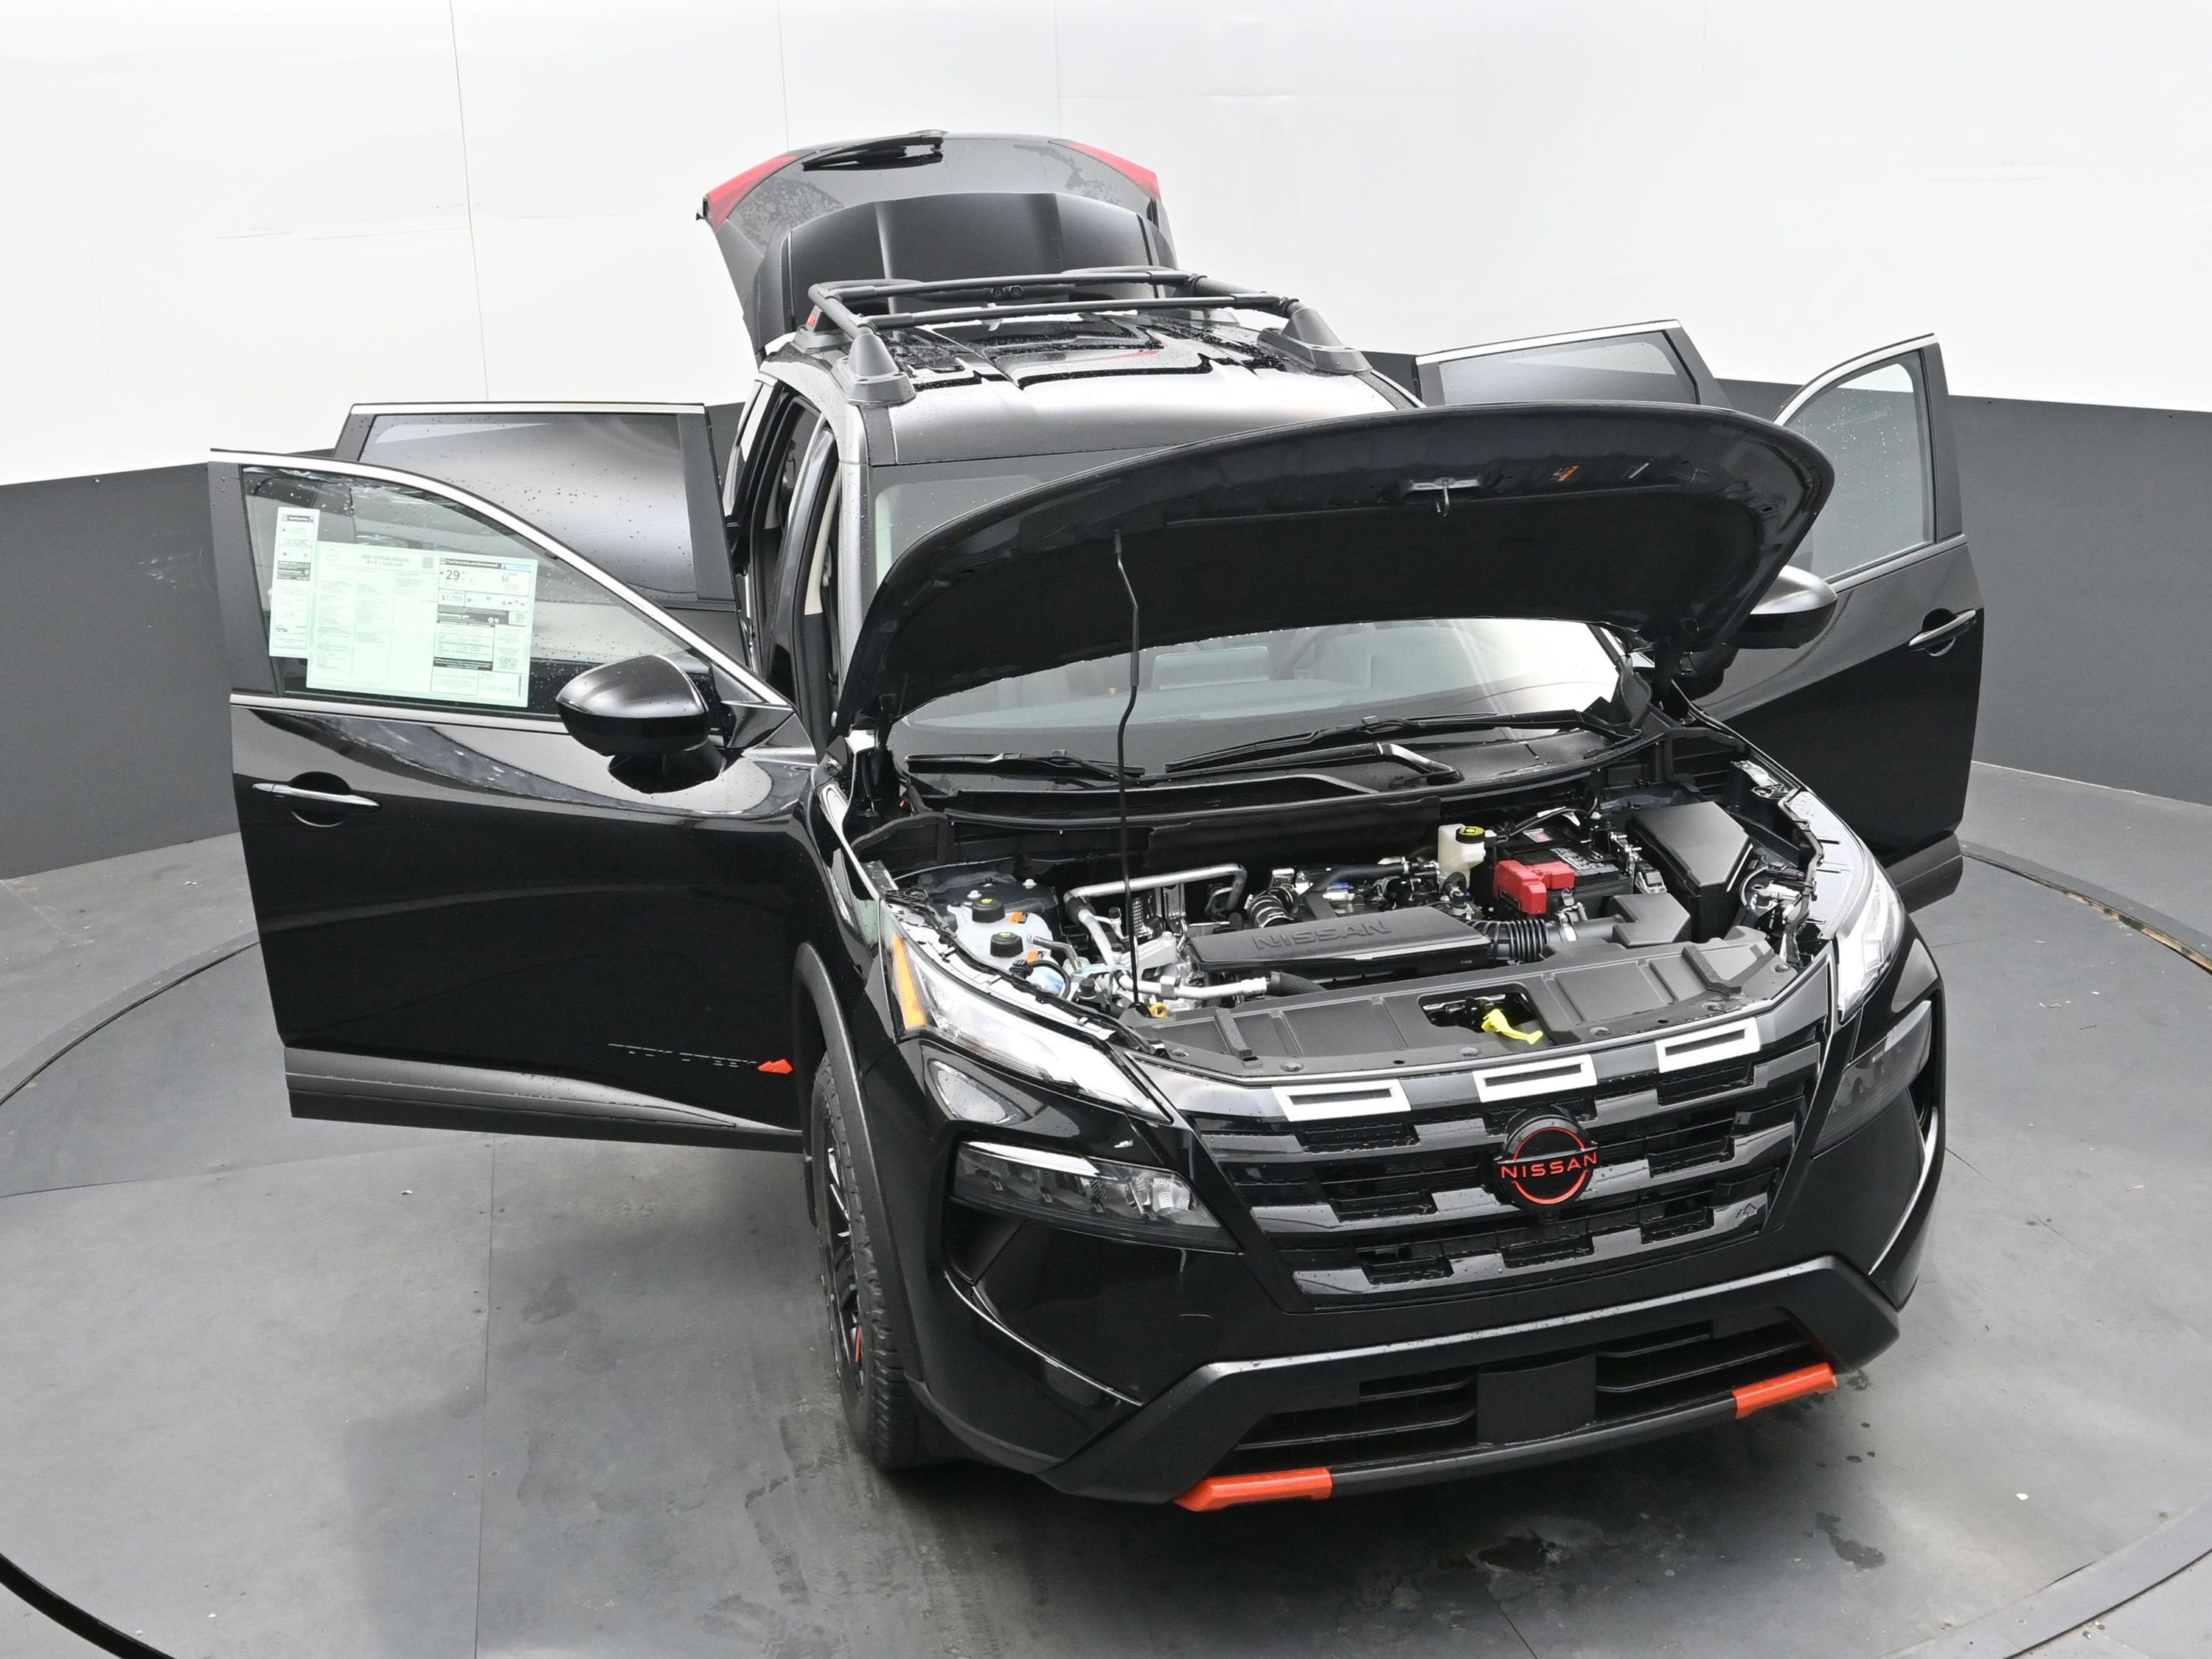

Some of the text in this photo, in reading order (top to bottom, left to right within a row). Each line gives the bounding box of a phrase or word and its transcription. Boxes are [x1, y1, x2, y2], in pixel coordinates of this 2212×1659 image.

[445, 569, 460, 580] 29
[1252, 920, 1391, 950] NISSAN
[1500, 1151, 1598, 1179] NISSAN
